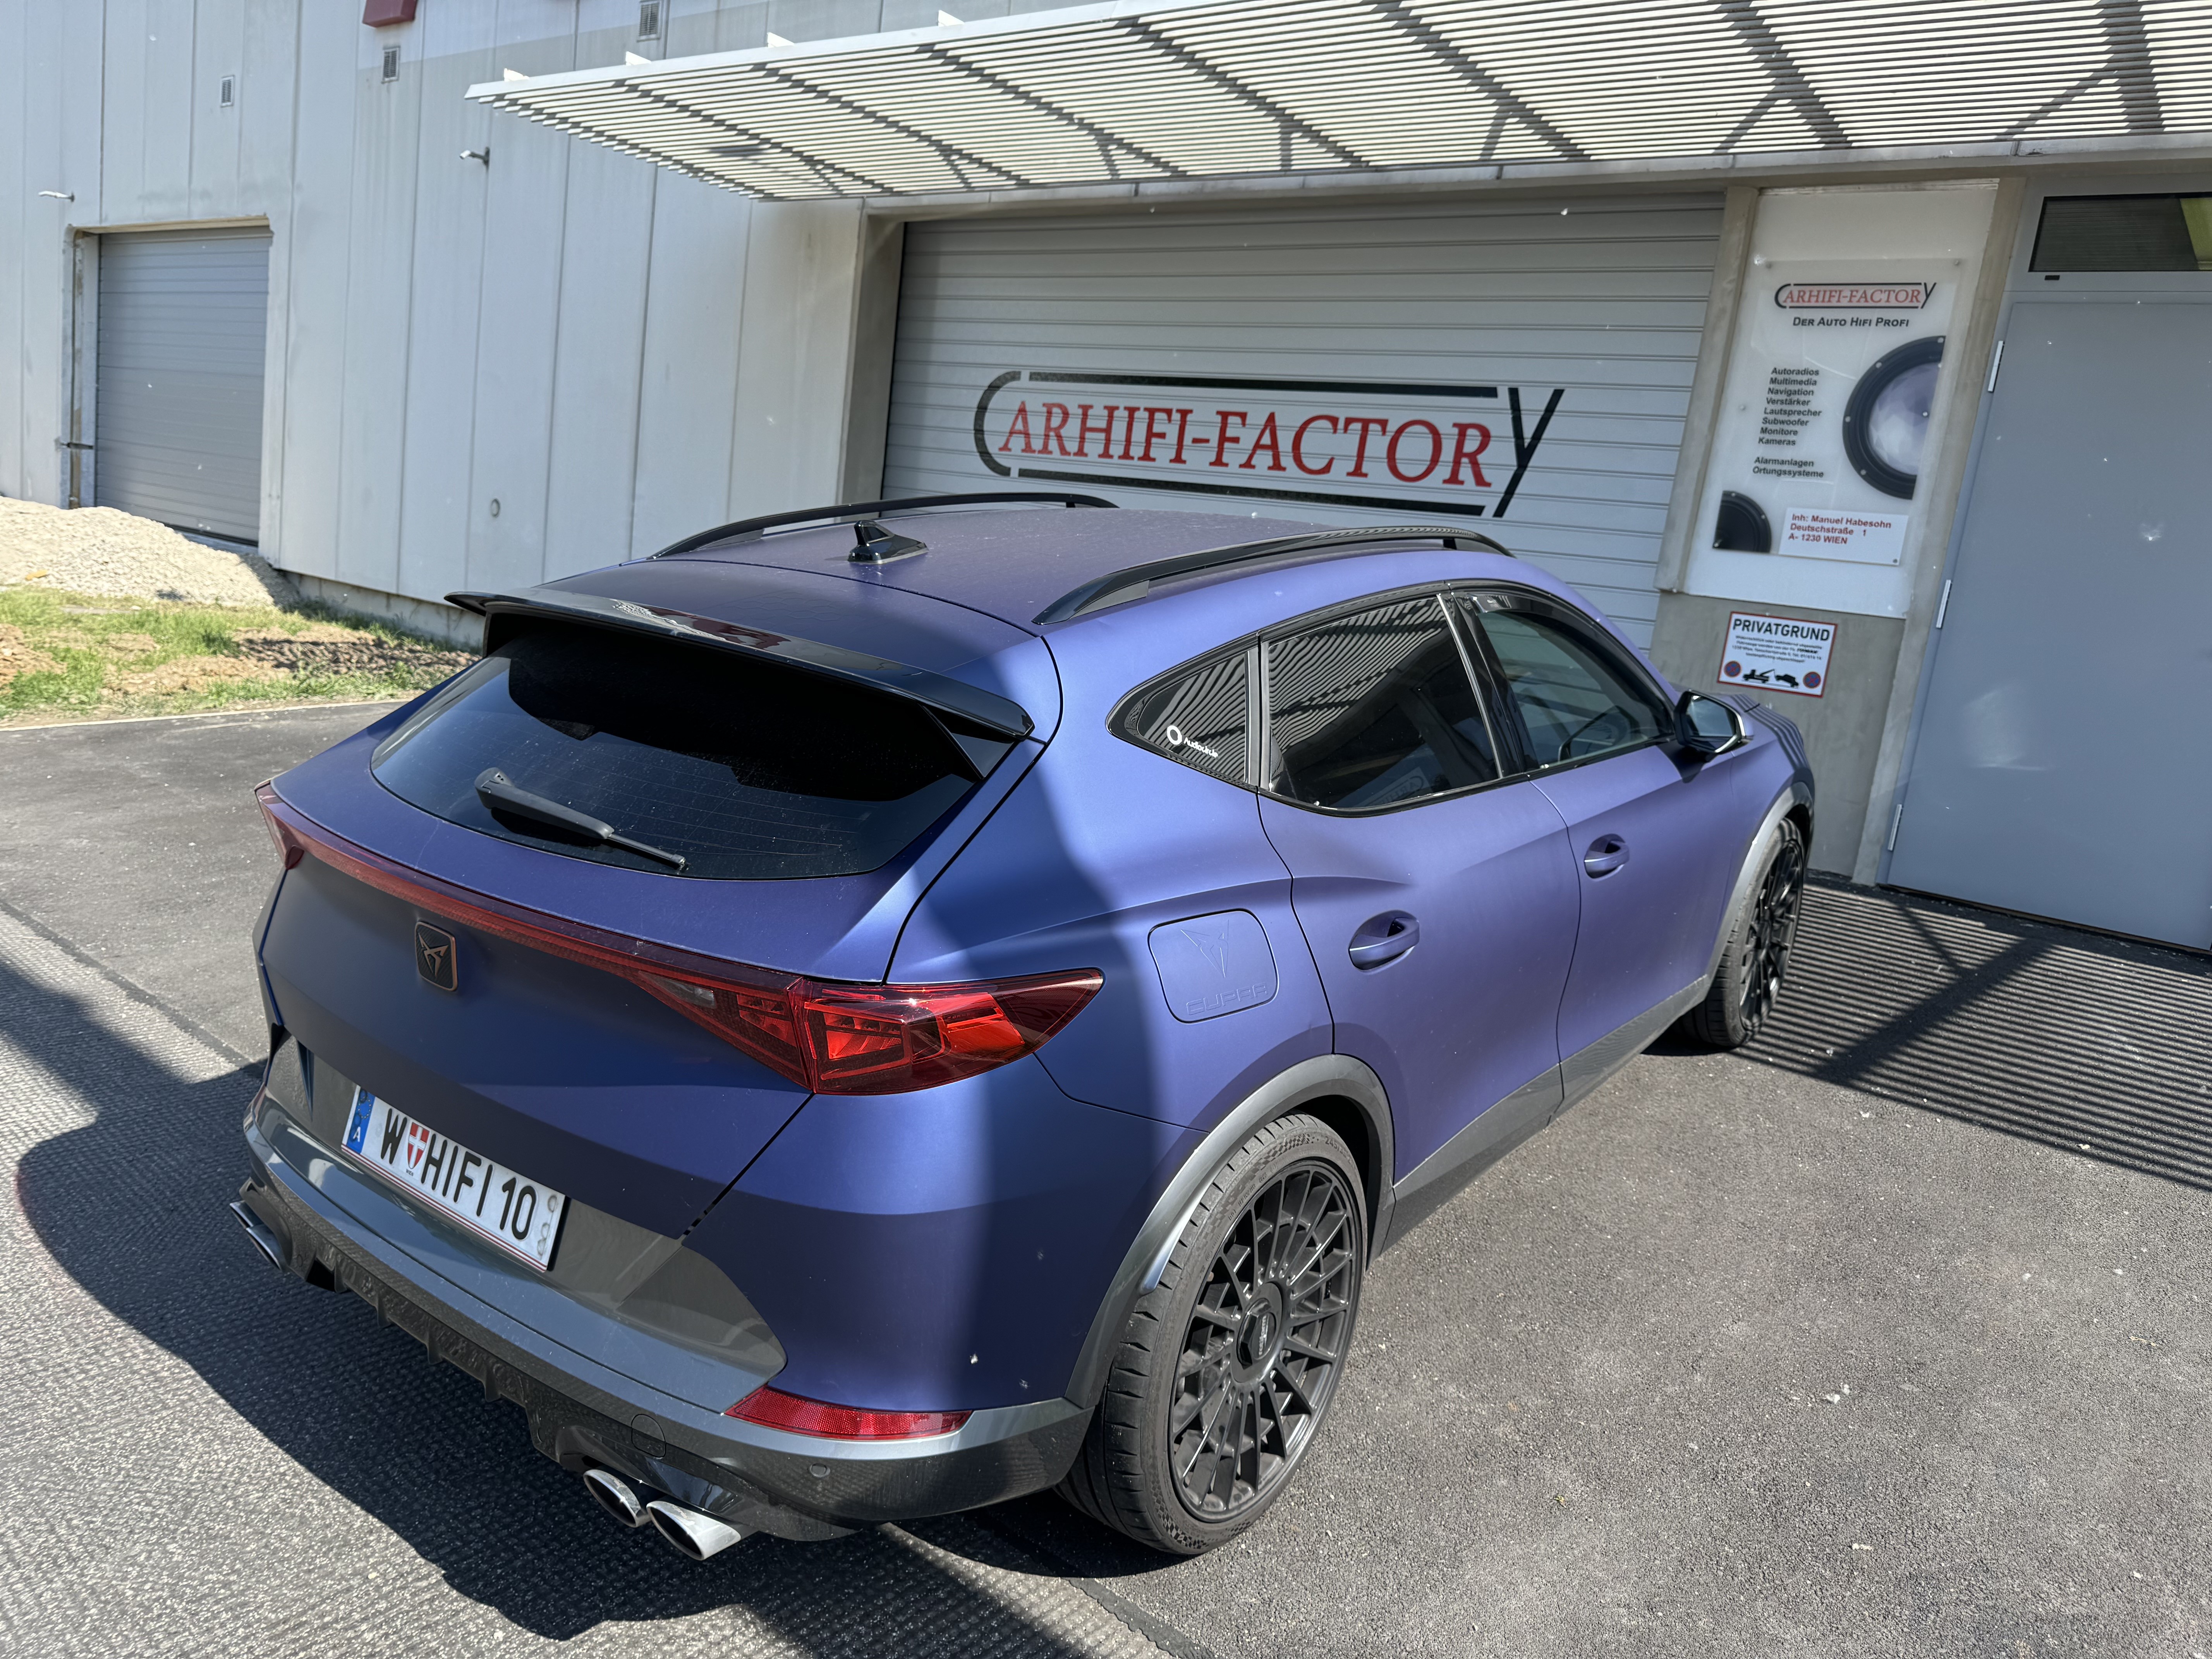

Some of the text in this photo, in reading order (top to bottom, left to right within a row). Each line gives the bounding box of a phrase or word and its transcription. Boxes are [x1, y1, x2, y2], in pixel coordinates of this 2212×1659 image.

[1771, 367, 1820, 376] Autoradios
[1769, 377, 1817, 386] Multimedia
[1767, 387, 1814, 397] Navigation
[1766, 397, 1811, 406] Verstärker
[1764, 407, 1822, 417] Lautsprecher
[1762, 416, 1810, 426] Subwoofer
[1760, 426, 1798, 436] Monitore
[1758, 436, 1796, 446] Kameras
[1754, 456, 1814, 468] Alarmanlagen
[1752, 466, 1824, 478] Ortungssysteme
[1791, 514, 1892, 529] Inh: Manuel Habesohn
[1790, 522, 1867, 537] Deutschstraße 1
[1801, 533, 1821, 543] 1230
[1823, 535, 1848, 544] WIEN
[1732, 618, 1830, 641] PRIVATGRUND
[1186, 982, 1268, 1016] CUPRA
[353, 1126, 361, 1142] A
[380, 1108, 408, 1164] W
[500, 1177, 537, 1240] 10
[406, 1168, 414, 1177] WIEN
